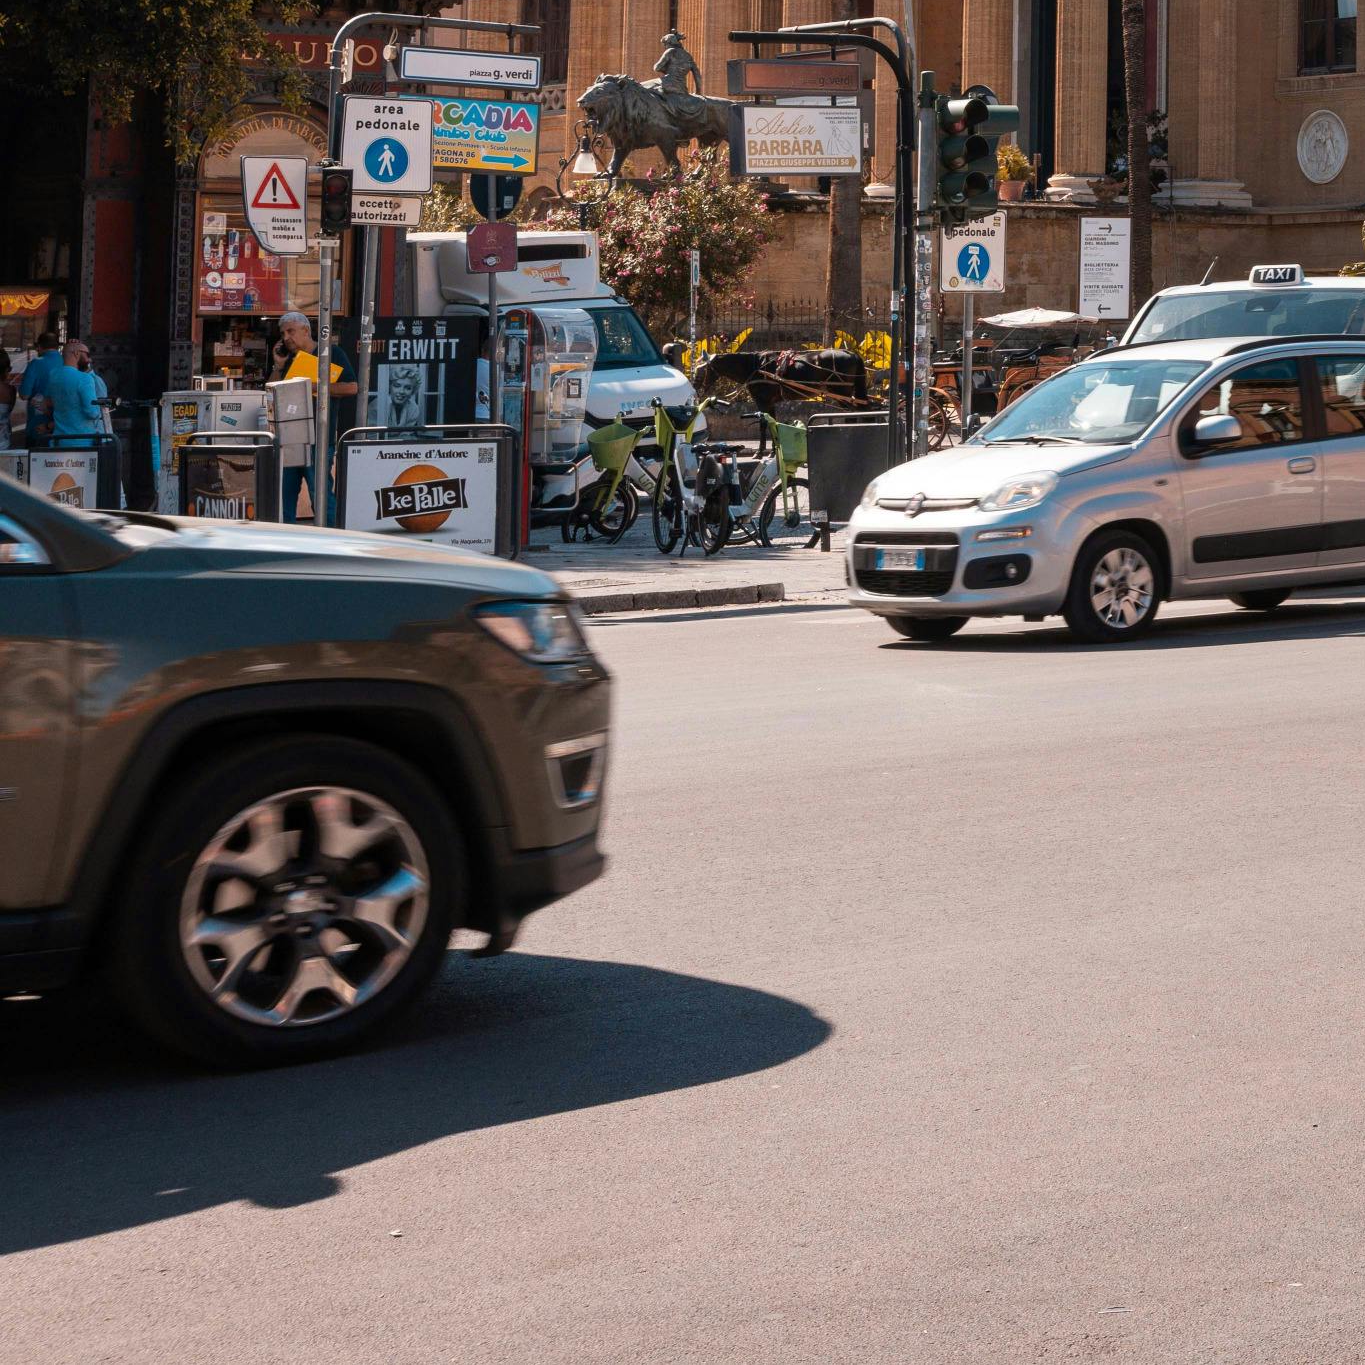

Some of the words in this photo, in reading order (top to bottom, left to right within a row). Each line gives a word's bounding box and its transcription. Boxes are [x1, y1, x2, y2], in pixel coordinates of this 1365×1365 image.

[469, 69, 492, 78] piazza
[493, 69, 503, 80] g.
[505, 69, 533, 80] verdi
[374, 104, 404, 115] area
[433, 100, 534, 133] RCADIA
[355, 119, 420, 131] pedonale
[747, 112, 817, 135] Atelier
[433, 125, 471, 140] imbo
[751, 157, 778, 167] PIAZZA
[780, 157, 816, 167] GIUSEPPE
[817, 157, 839, 166] VERDI
[359, 200, 400, 209] eccetto
[351, 211, 407, 222] autorizzati
[953, 227, 996, 237] pedonale
[1259, 268, 1291, 280] TAXI
[388, 338, 460, 360] ERWITT
[174, 404, 198, 417] EGADI
[620, 399, 651, 411] IVEC
[376, 450, 422, 460] Arancine
[425, 449, 469, 460] d'Autore
[196, 496, 246, 521] CANNOLI
